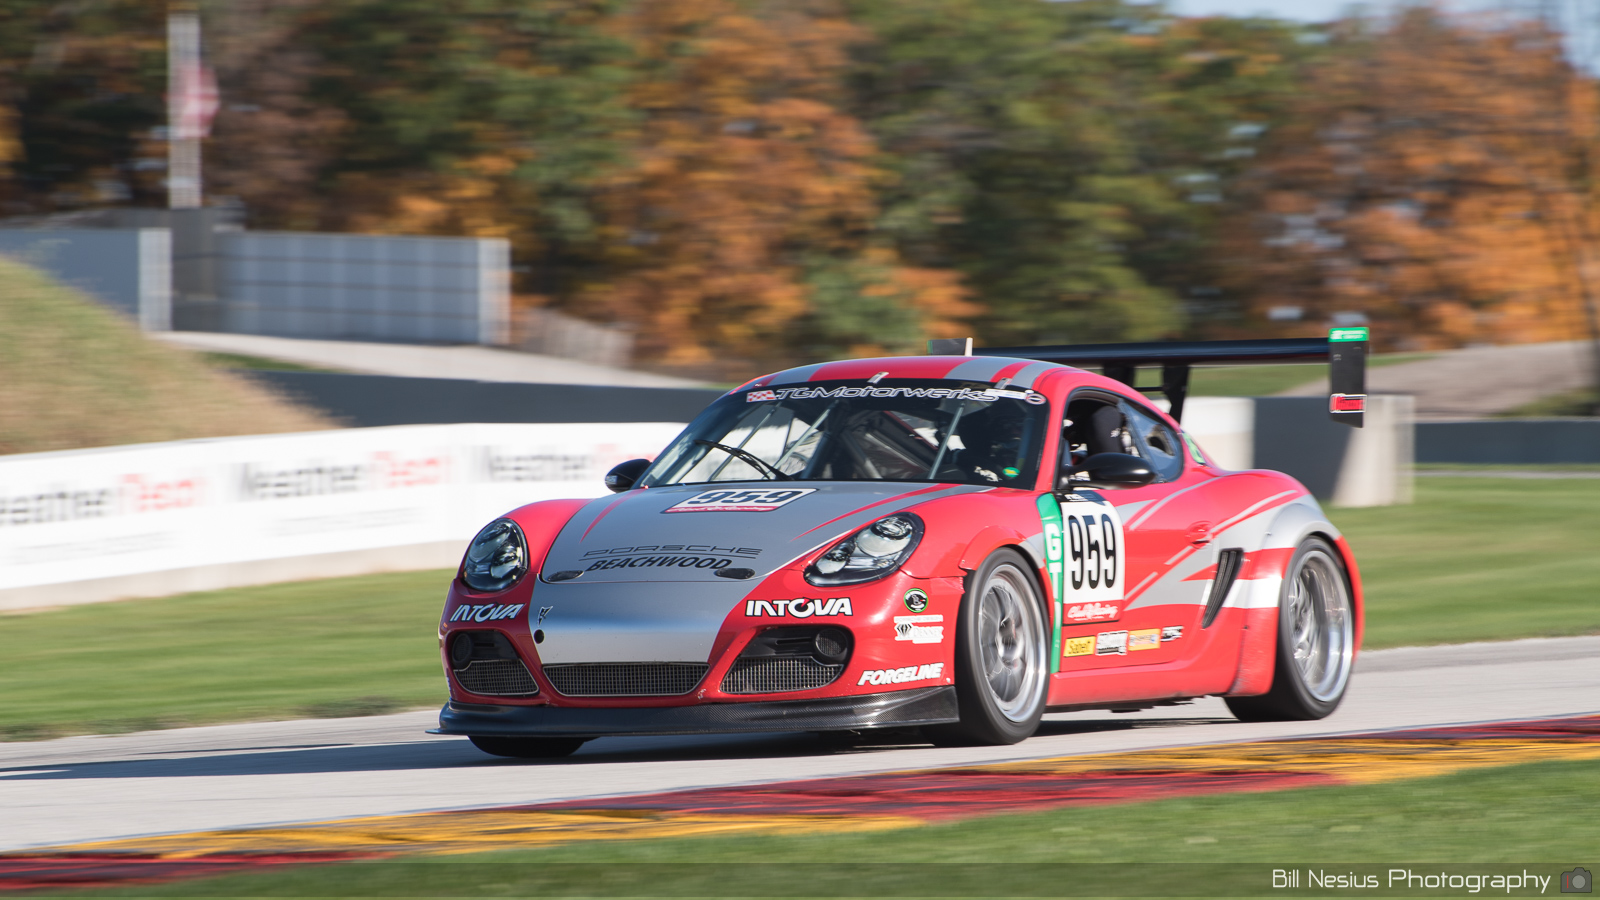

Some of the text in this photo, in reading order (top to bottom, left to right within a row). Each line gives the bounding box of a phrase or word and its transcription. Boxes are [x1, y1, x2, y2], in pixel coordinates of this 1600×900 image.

[687, 489, 797, 505] 959
[583, 544, 762, 557] PORSCHE
[1068, 513, 1116, 590] 959
[585, 555, 733, 572] BEACHWOOD
[449, 602, 526, 623] INTOVA
[745, 597, 853, 619] INTOVA
[857, 662, 944, 686] FORGELINE
